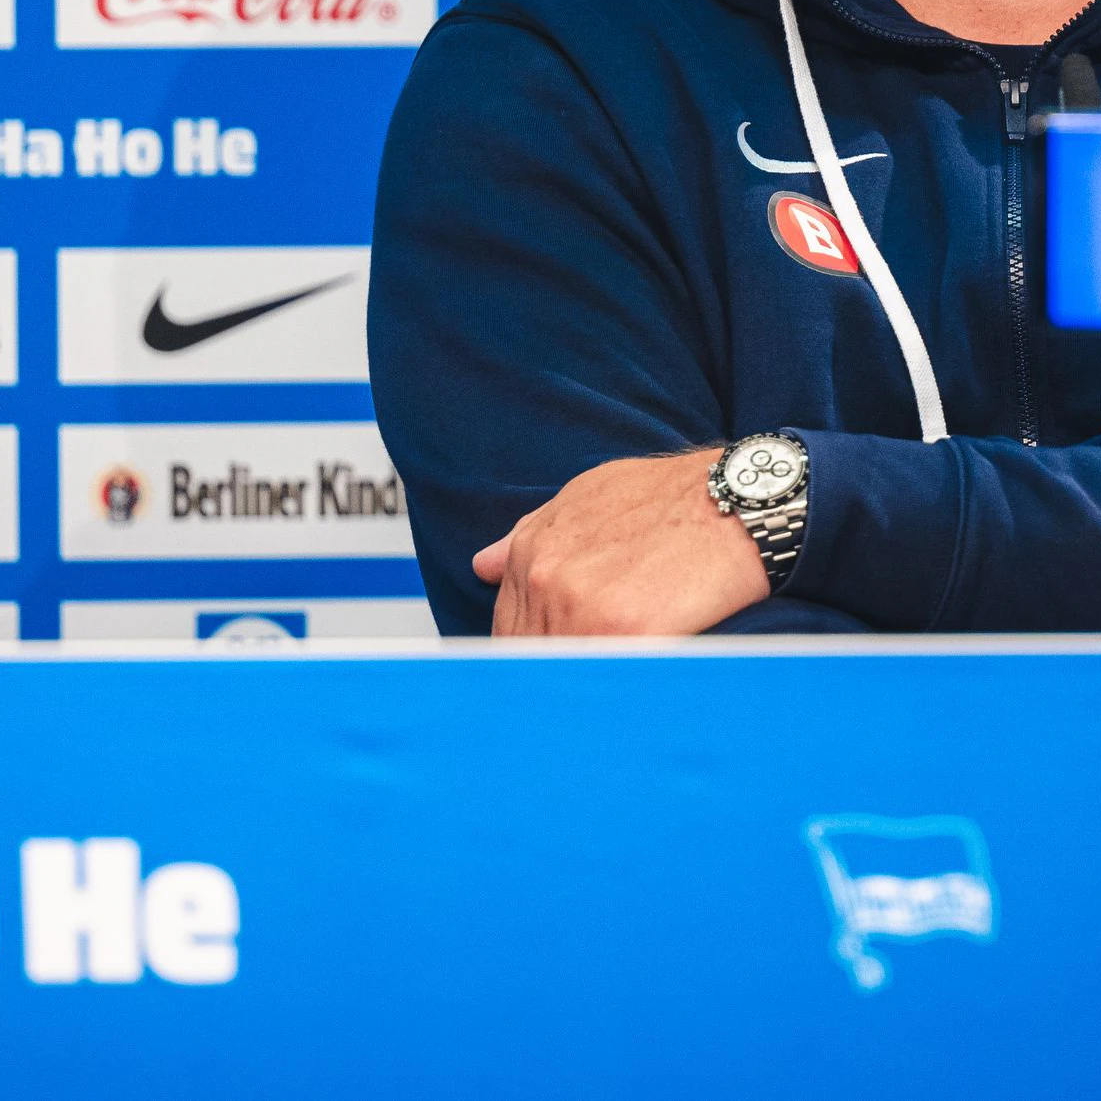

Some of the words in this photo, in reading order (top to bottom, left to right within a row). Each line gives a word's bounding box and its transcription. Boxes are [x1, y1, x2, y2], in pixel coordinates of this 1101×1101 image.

[73, 117, 164, 177] Ho
[172, 117, 258, 176] He
[170, 461, 306, 518] Berliner
[20, 836, 241, 985] He
